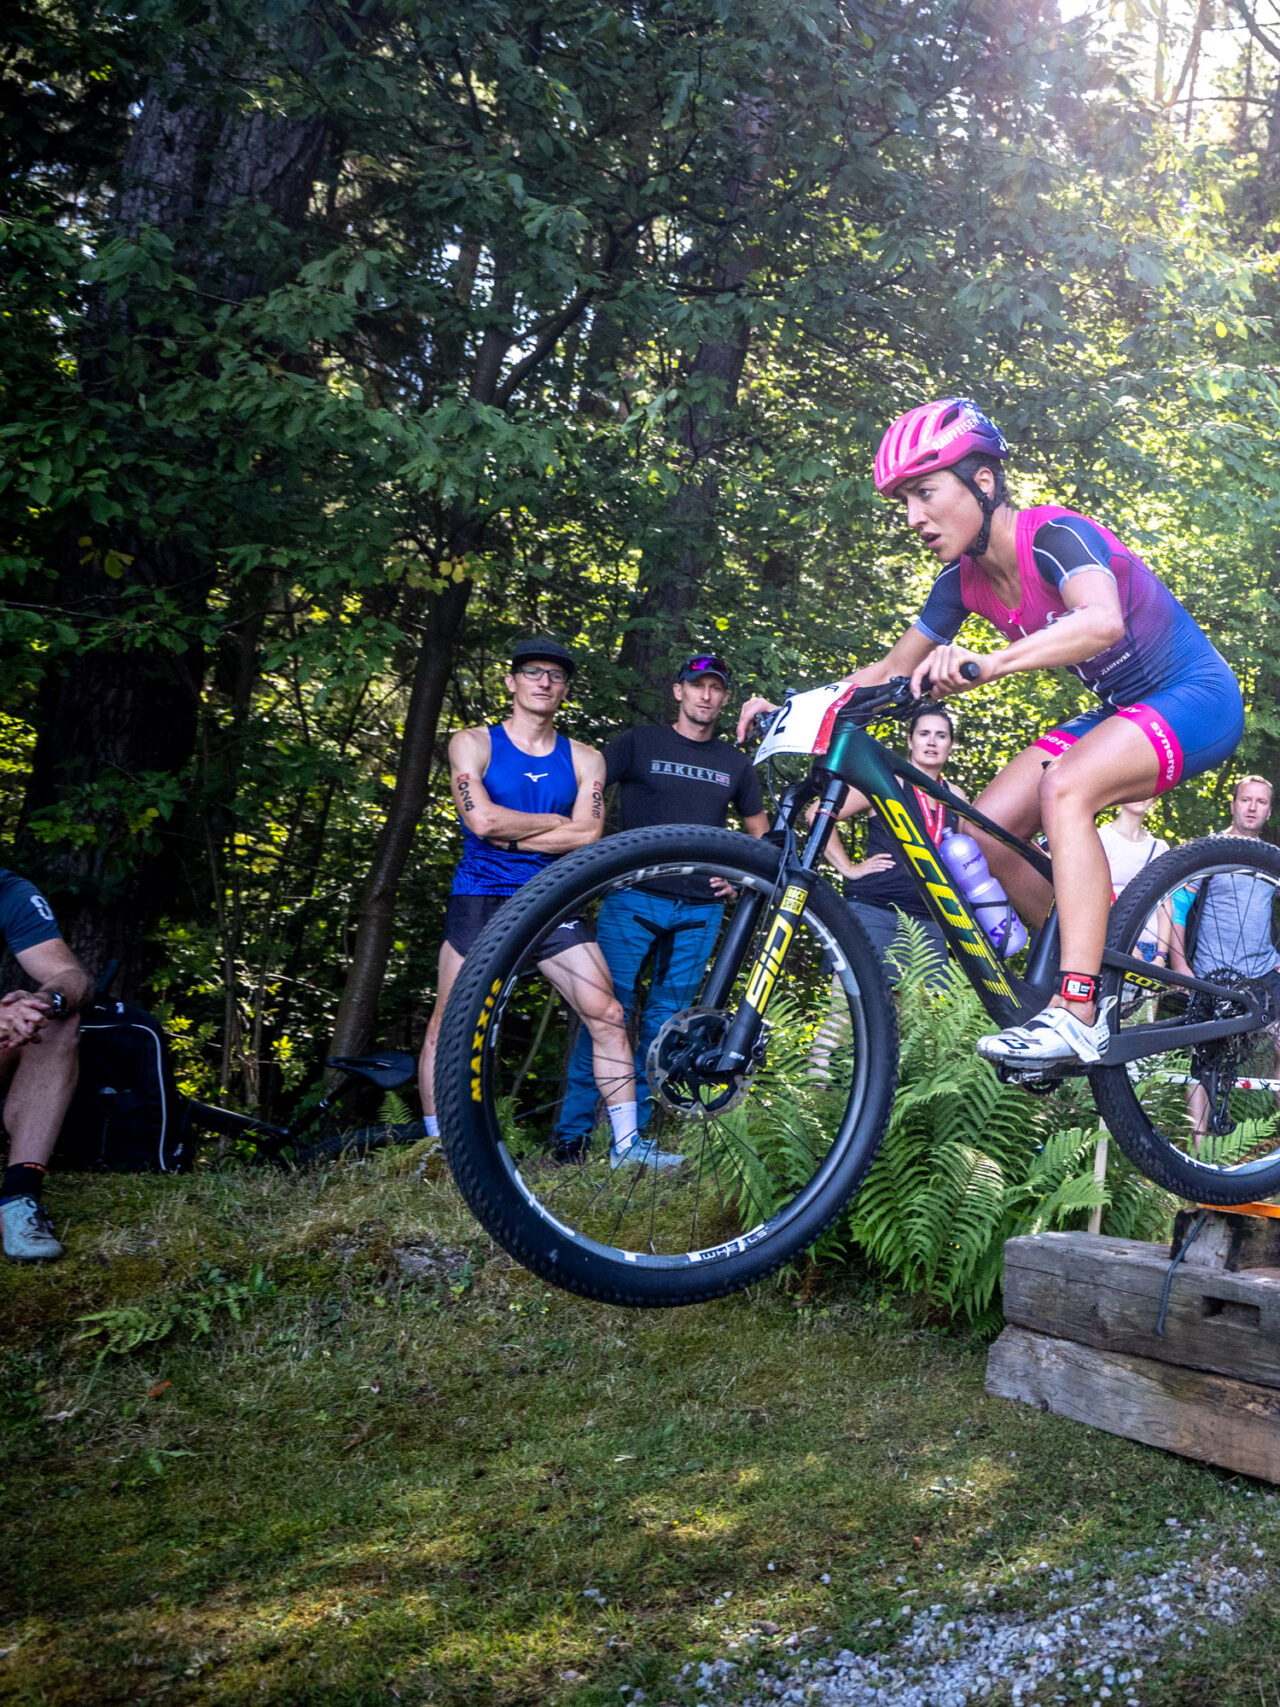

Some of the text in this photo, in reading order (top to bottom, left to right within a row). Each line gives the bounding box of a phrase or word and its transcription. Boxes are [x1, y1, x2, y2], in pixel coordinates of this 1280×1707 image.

[1040, 735, 1072, 750] nerg
[1150, 722, 1175, 780] synergy
[651, 762, 714, 780] OAKLEY
[872, 795, 1022, 1008] SCOTT
[1124, 971, 1171, 992] COT
[470, 978, 502, 1102] MAXXIS
